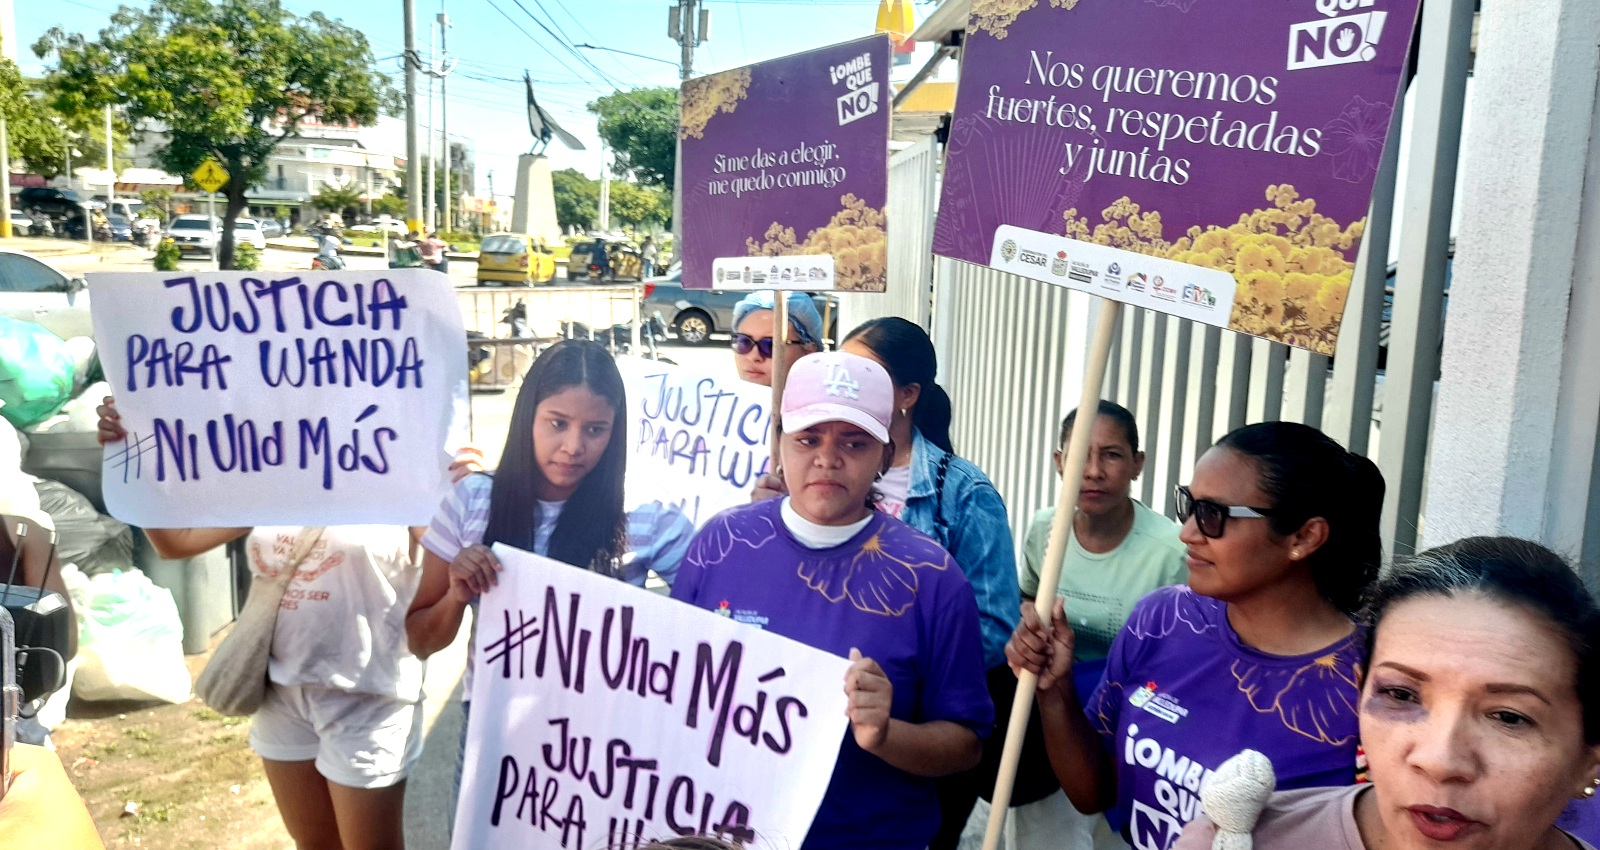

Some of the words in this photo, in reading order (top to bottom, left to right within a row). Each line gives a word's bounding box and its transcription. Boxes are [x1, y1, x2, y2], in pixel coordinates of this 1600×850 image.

[1294, 11, 1388, 63] NO!
[841, 82, 880, 121] NO!
[846, 69, 873, 91] QUE
[1025, 50, 1085, 88] Nos
[1092, 63, 1279, 106] queremos
[985, 85, 1097, 134] fuertes,
[1105, 108, 1323, 158] respetadas
[708, 178, 729, 196] me
[731, 169, 775, 199] quedo
[777, 165, 847, 189] conmigo
[713, 153, 726, 174] Si
[728, 153, 749, 172] me
[751, 148, 776, 169] das
[778, 149, 788, 165] a
[791, 139, 840, 166] elegir,
[1058, 142, 1084, 176] y
[1083, 138, 1191, 186] juntas
[1019, 252, 1047, 268] CESAR
[164, 276, 408, 334] JUSTICIA
[127, 334, 232, 392] PARA
[258, 336, 424, 389] WANDA
[823, 361, 860, 400] LA
[643, 373, 771, 446] JUSTICI
[636, 417, 711, 477] PARA
[491, 755, 587, 850] PARA
[541, 717, 755, 846] JUSTICIA
